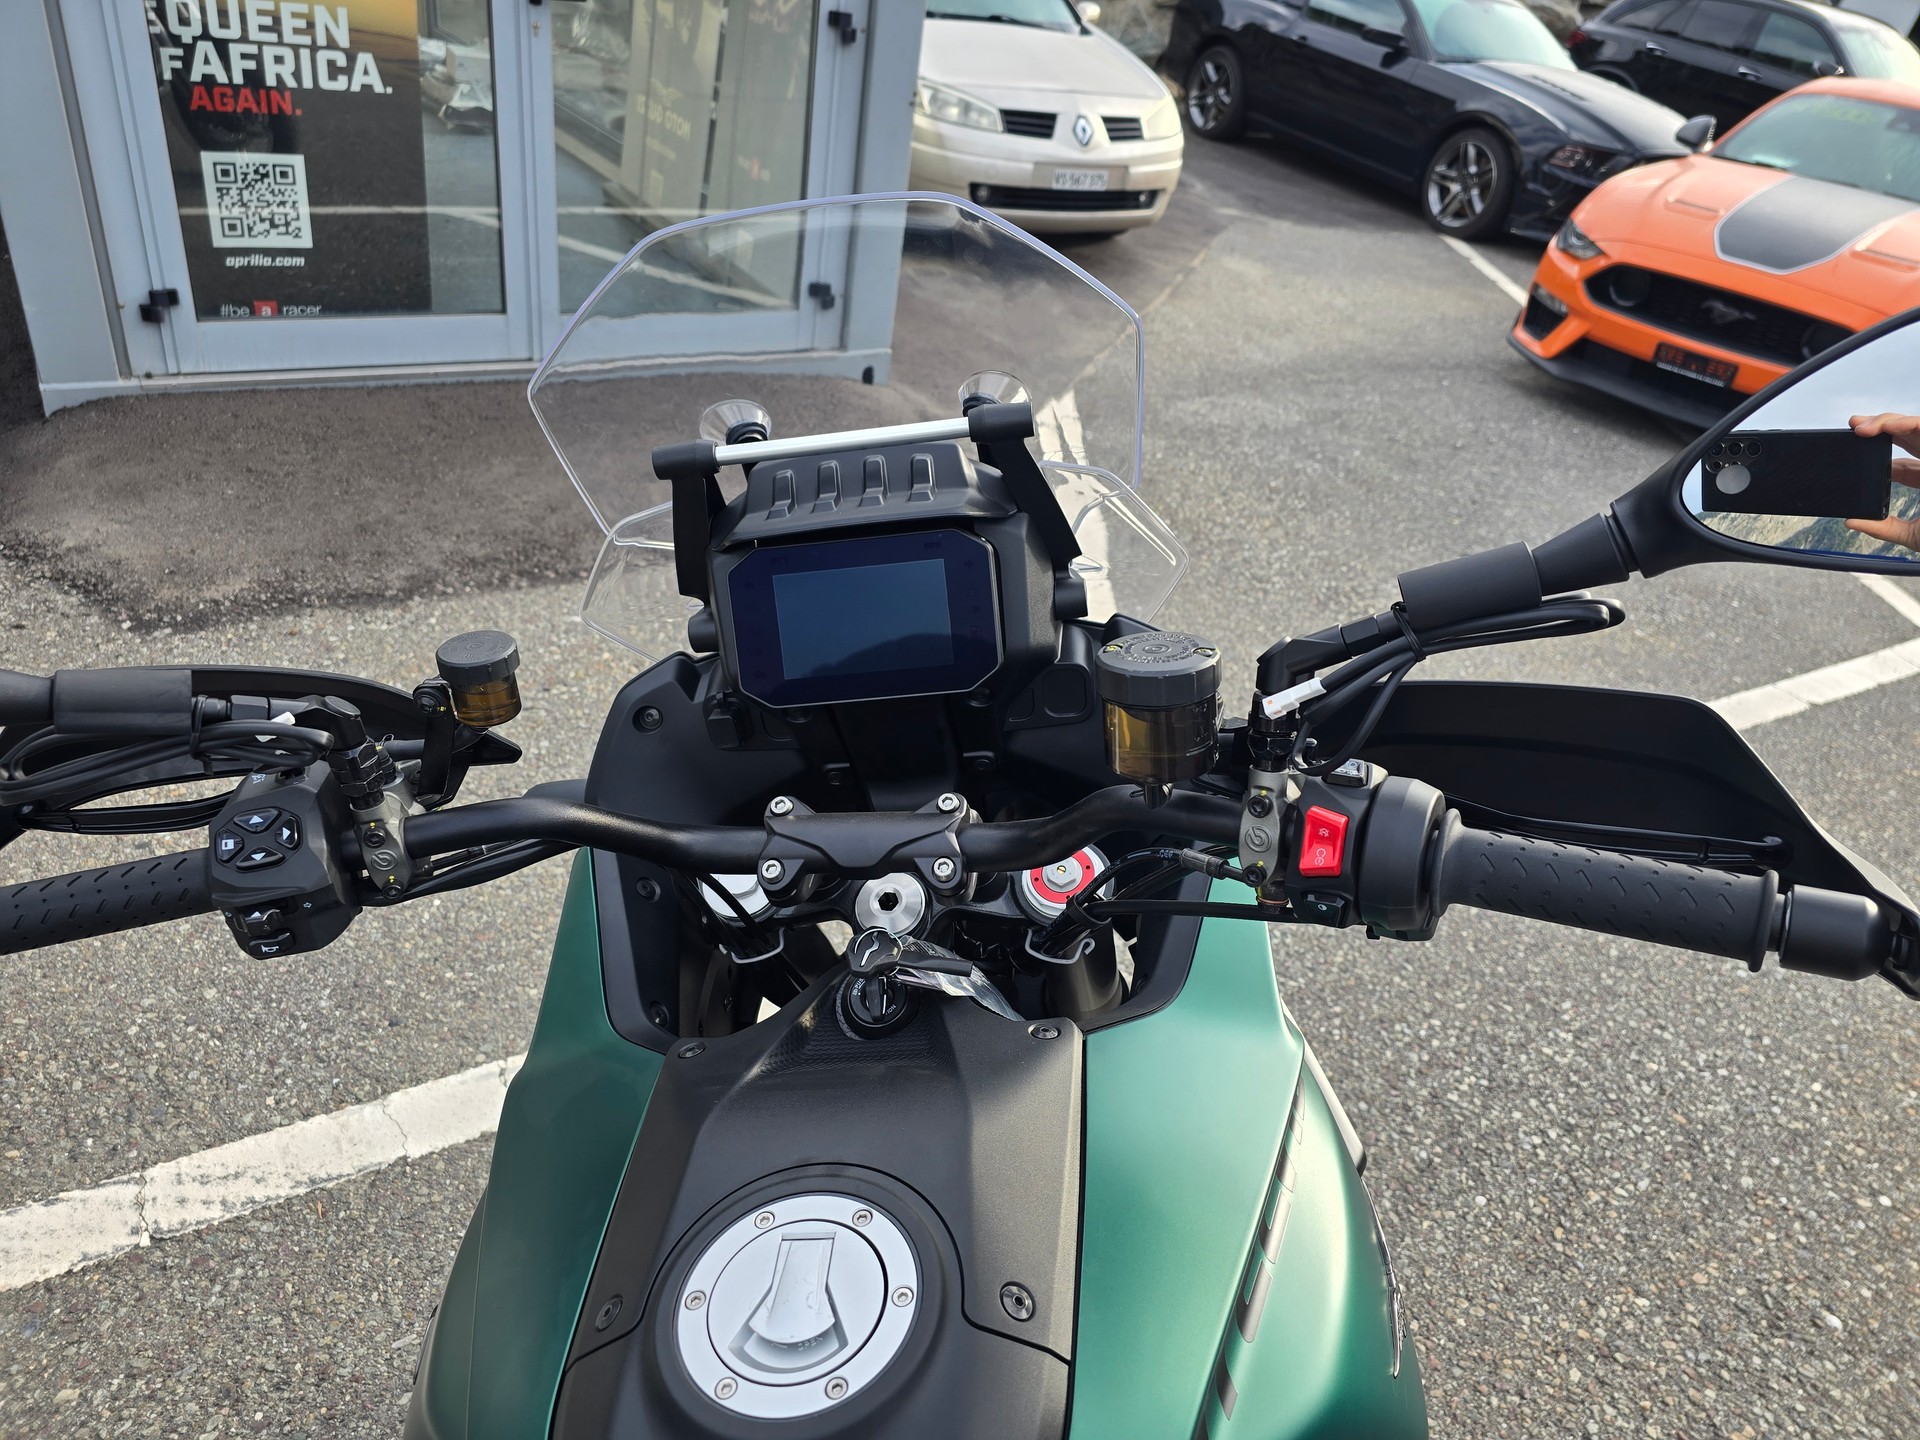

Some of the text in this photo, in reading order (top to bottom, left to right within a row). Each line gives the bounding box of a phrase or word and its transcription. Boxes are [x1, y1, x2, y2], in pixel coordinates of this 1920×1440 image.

[165, 0, 350, 48] QUEEN
[190, 40, 393, 94] AFRICA.
[190, 85, 302, 116] AGAIN.
[225, 253, 305, 269] aprilia.com
[220, 304, 250, 318] #be
[283, 305, 322, 317] racer
